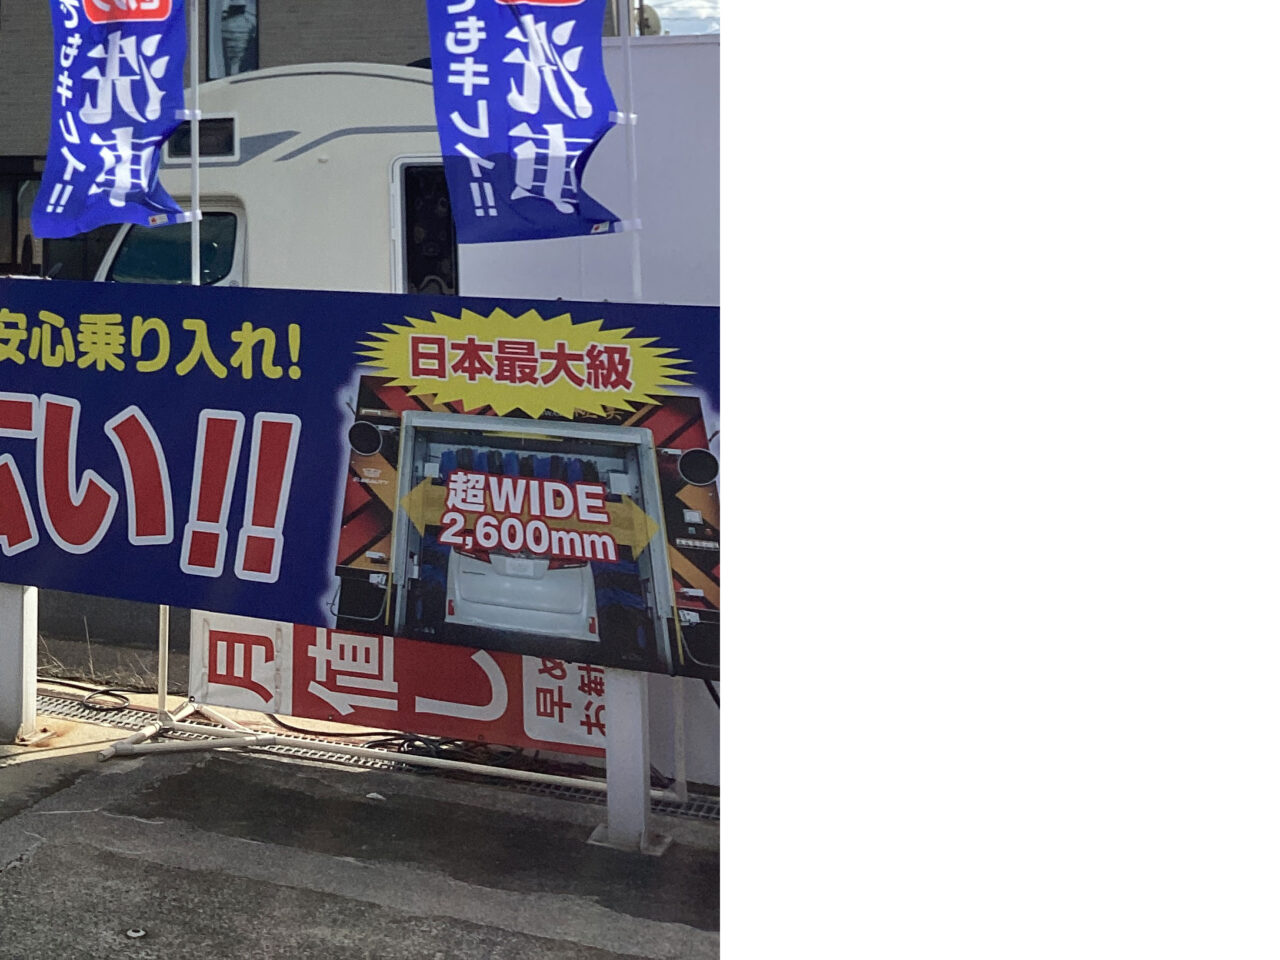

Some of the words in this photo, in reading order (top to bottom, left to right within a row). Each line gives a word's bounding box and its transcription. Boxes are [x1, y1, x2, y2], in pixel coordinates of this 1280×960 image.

[409, 334, 634, 391] 日本最大級
[446, 471, 609, 523] 超WIDE
[439, 511, 617, 562] 2,600mm
